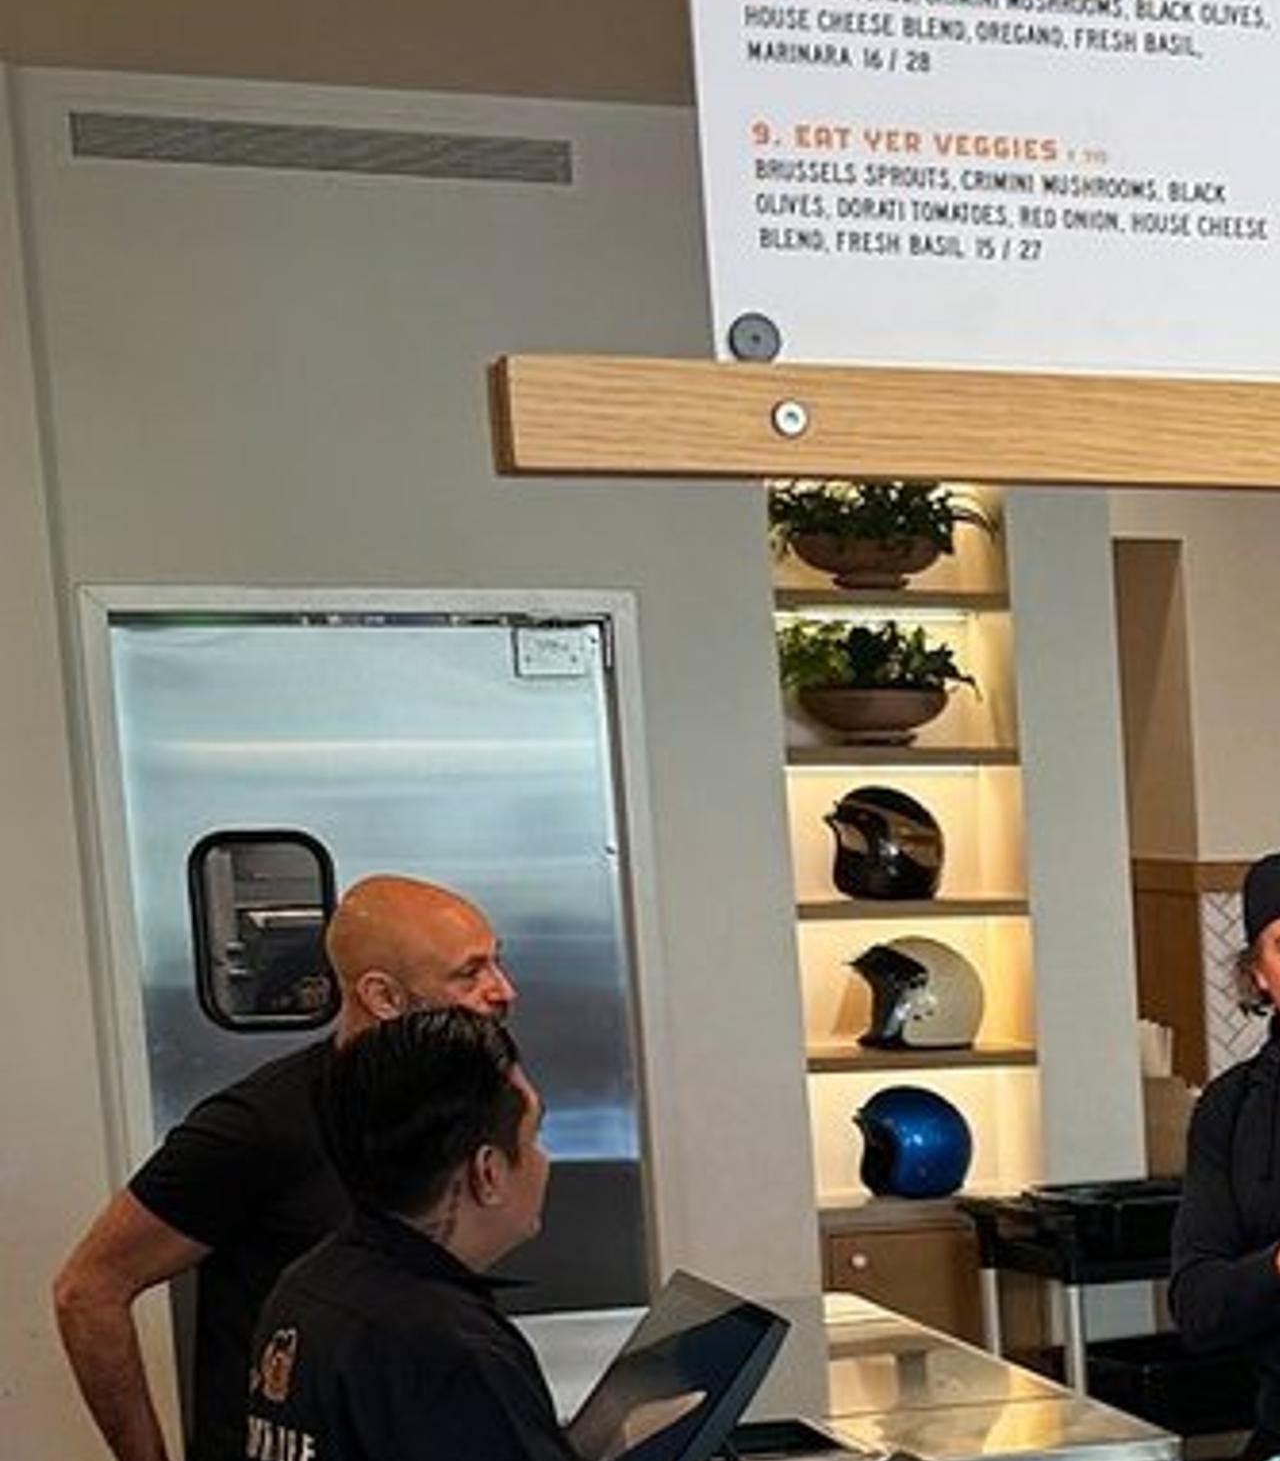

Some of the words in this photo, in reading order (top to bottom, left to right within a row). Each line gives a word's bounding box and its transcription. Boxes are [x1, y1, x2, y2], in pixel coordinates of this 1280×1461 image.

[751, 120, 782, 147] 9.
[793, 123, 853, 151] EAT
[862, 127, 923, 155] YER
[932, 131, 1059, 163] VEGGIES
